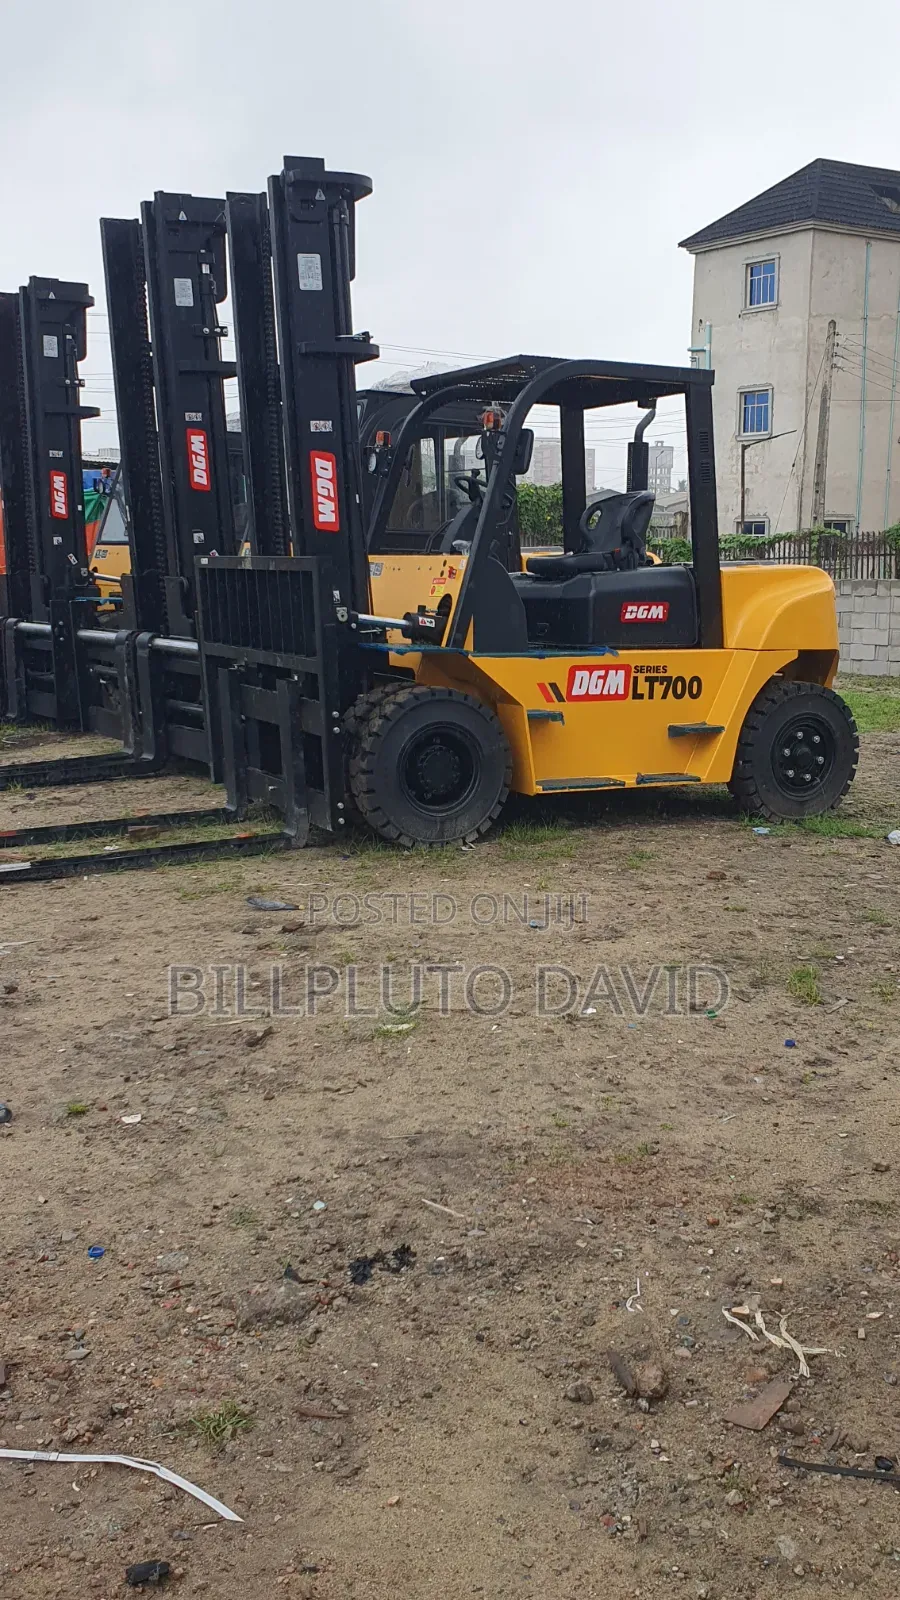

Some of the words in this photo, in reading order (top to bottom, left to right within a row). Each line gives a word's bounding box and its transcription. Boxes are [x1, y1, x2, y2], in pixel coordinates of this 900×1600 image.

[190, 435, 208, 486] DGM
[53, 475, 66, 515] DGM
[314, 457, 336, 523] DGM
[624, 605, 664, 620] DGM
[571, 670, 626, 696] DGM
[631, 675, 703, 700] LT700
[633, 665, 668, 674] SERIES
